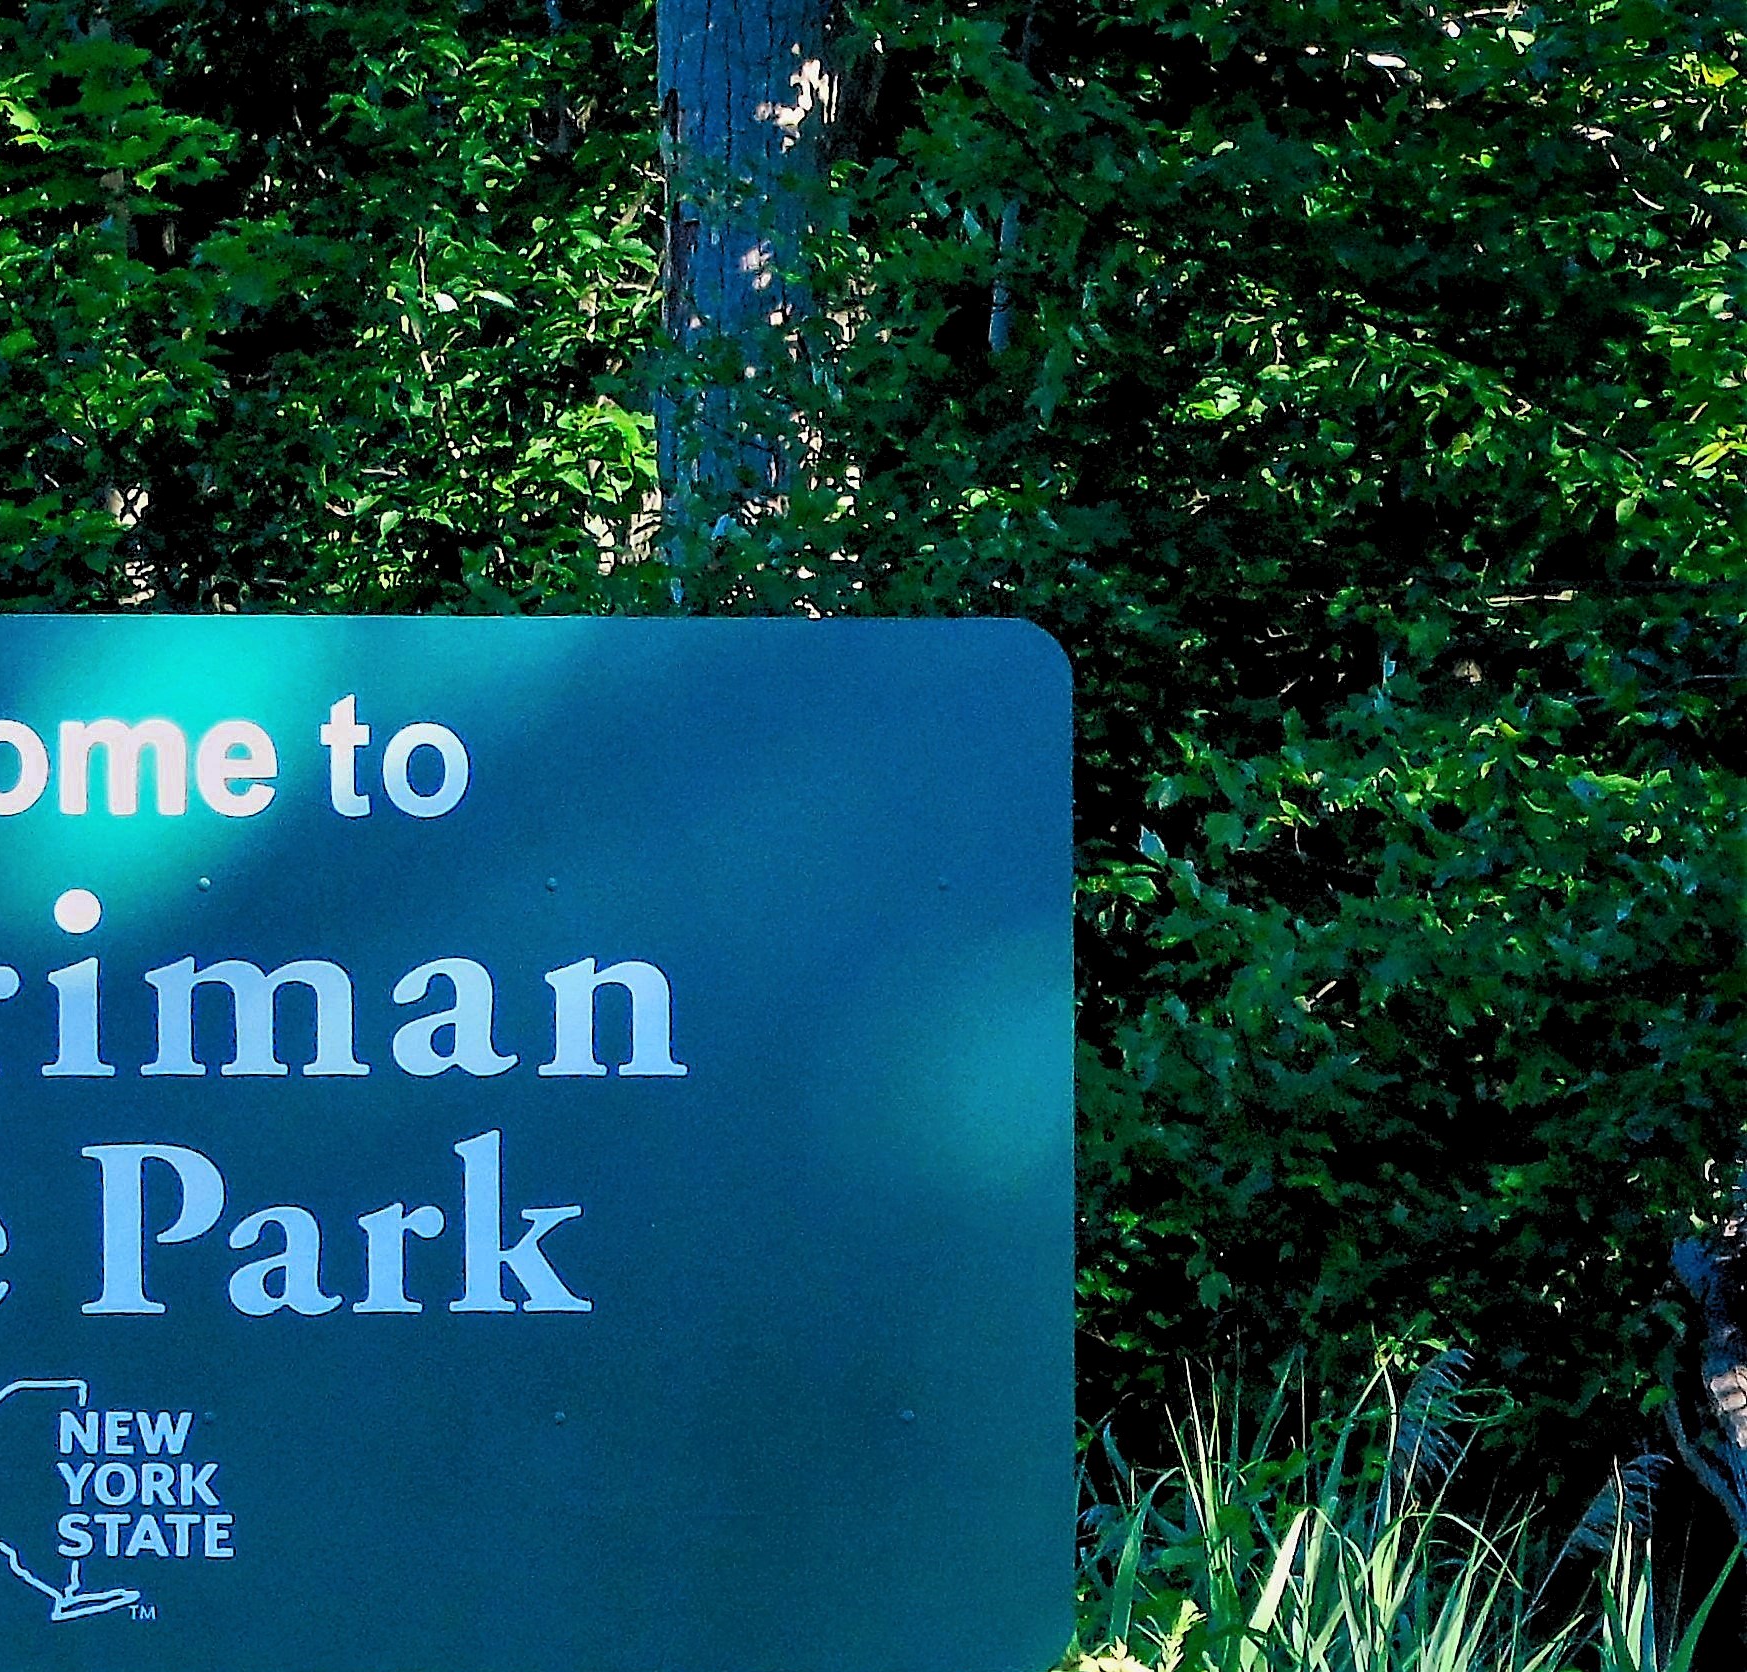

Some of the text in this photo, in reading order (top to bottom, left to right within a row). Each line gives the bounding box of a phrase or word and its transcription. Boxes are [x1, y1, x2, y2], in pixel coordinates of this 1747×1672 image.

[320, 694, 468, 817] to
[82, 1130, 591, 1315] Park
[60, 1412, 192, 1454] NEW
[57, 1463, 219, 1505] YORK
[59, 1514, 233, 1557] STATE
